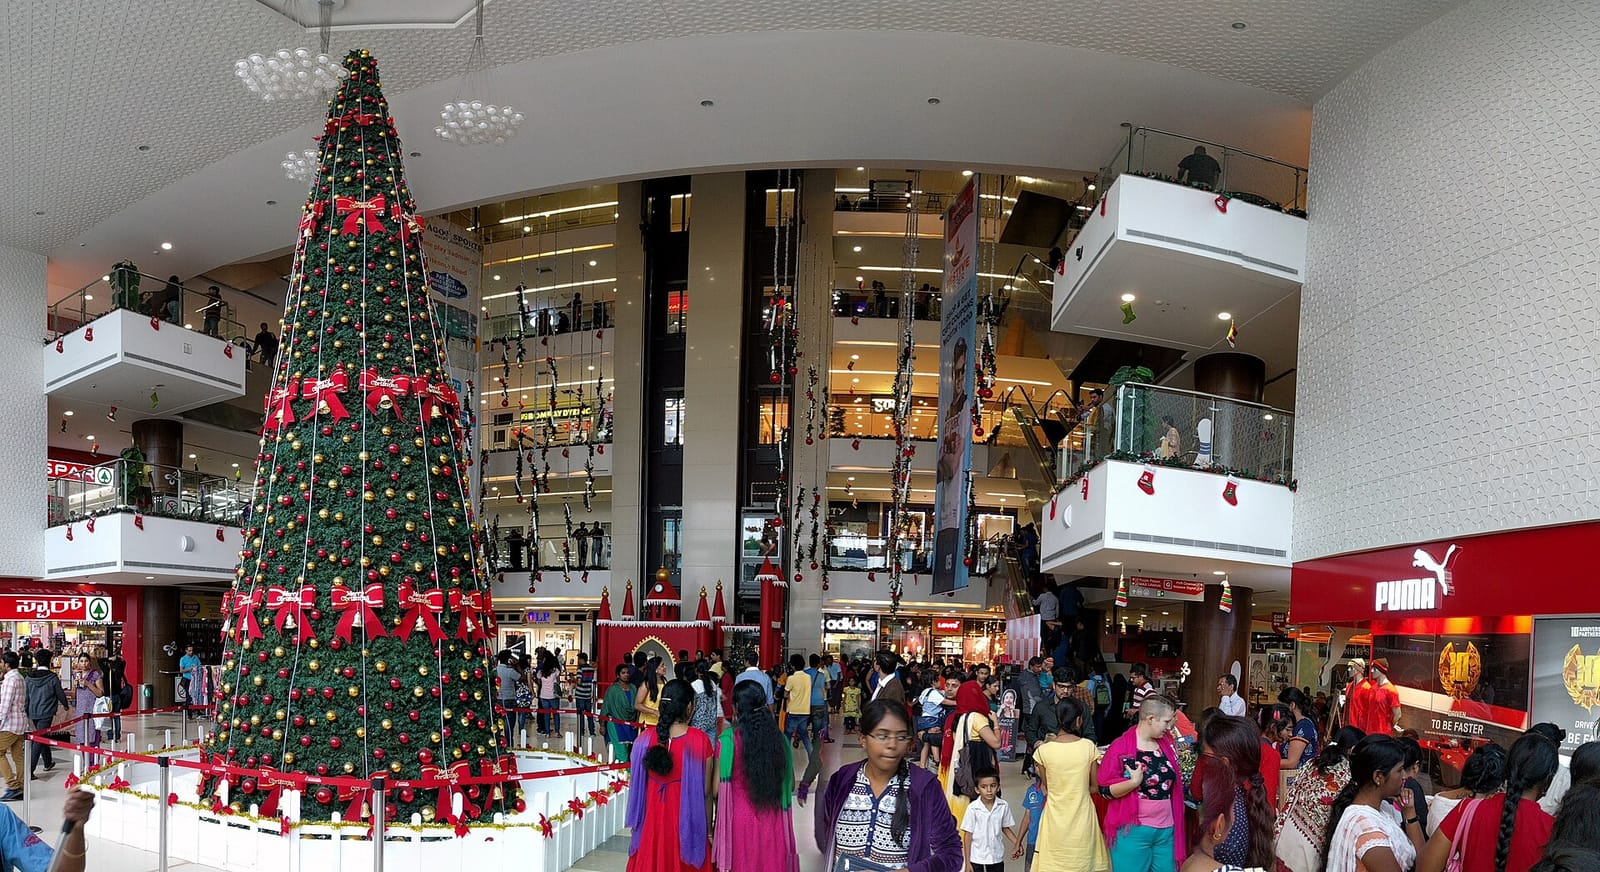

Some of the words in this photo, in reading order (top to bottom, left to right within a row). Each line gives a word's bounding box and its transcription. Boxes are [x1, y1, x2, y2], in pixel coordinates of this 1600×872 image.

[48, 462, 95, 480] SPAR
[1375, 577, 1435, 611] PUMA
[826, 616, 877, 631] adidas
[1431, 719, 1441, 730] TO
[1442, 720, 1453, 731] BE
[1454, 721, 1484, 735] FASTER
[1568, 732, 1581, 744] BE
